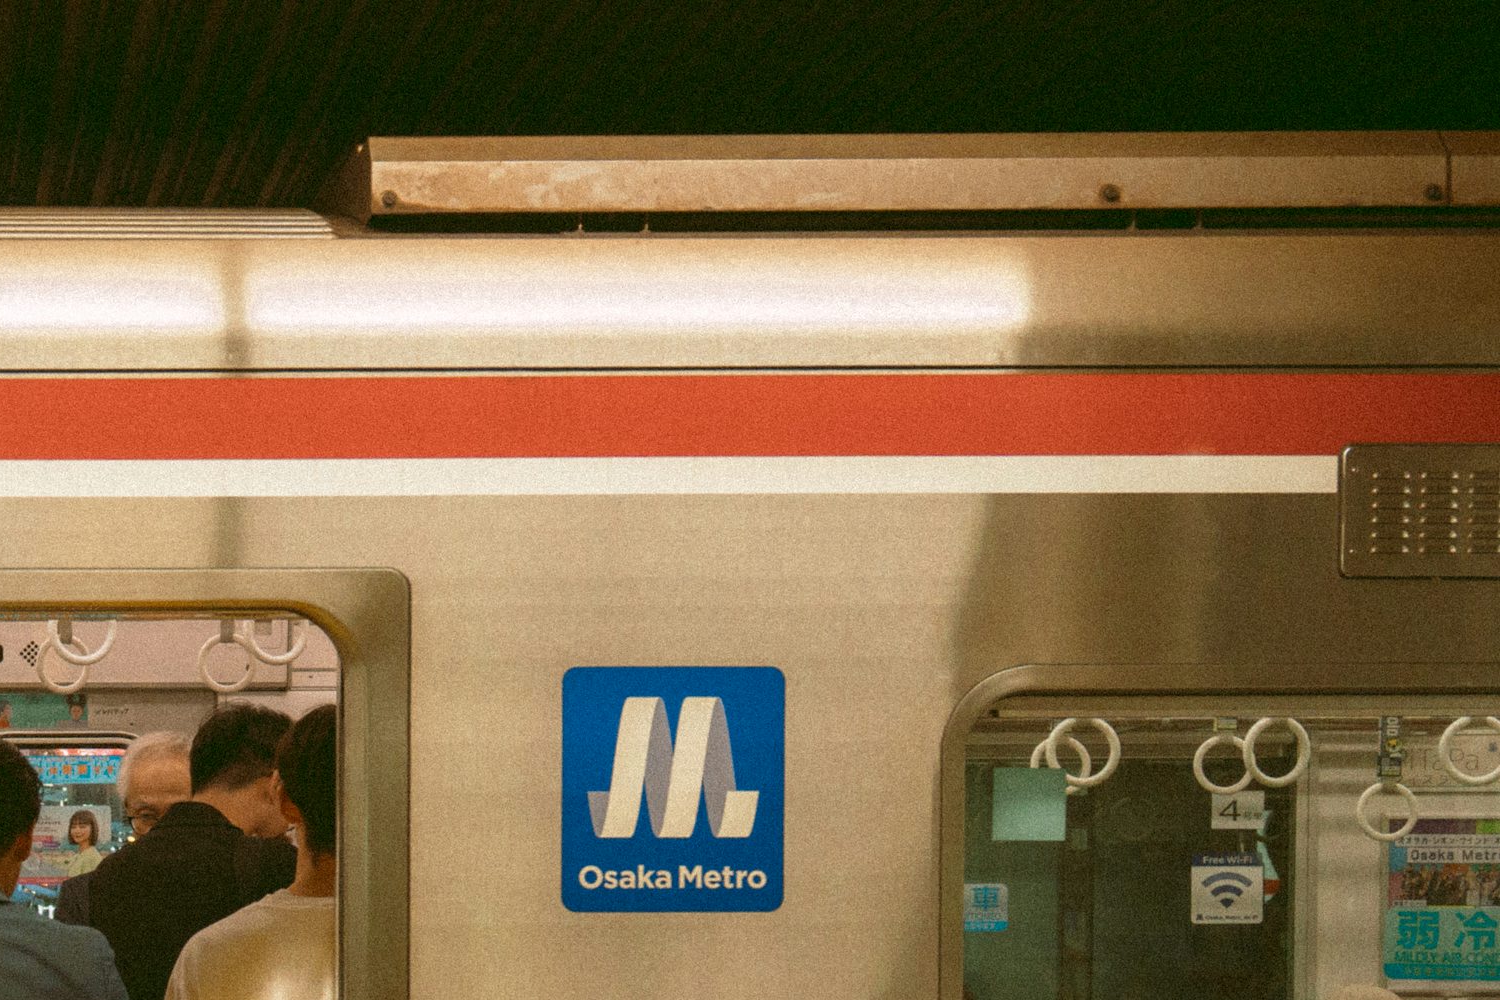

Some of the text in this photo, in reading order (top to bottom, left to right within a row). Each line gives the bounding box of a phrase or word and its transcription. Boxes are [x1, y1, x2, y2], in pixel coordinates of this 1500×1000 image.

[1203, 856, 1253, 865] Free Wi-Fi
[1411, 849, 1500, 861] Osaka Metr
[578, 864, 767, 889] Osaka Metro
